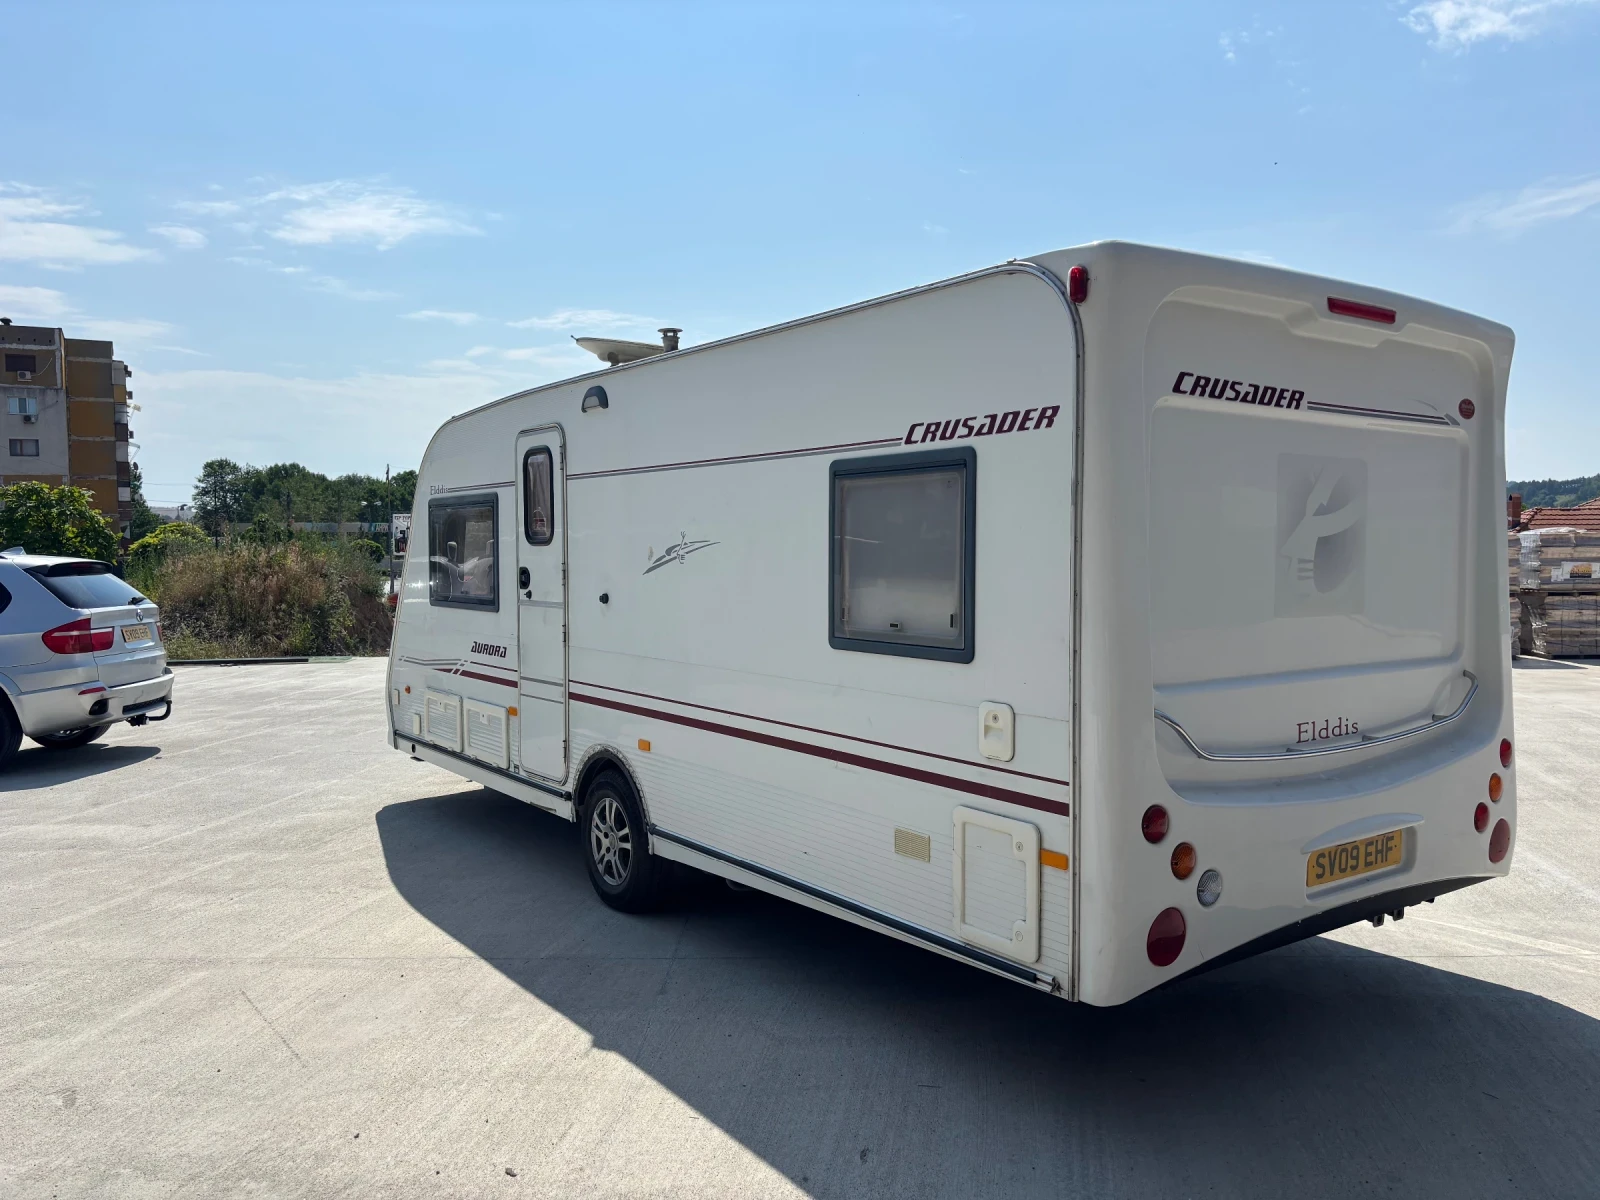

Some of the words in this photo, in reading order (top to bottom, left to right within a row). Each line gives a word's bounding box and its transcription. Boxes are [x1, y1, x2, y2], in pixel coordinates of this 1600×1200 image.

[1172, 371, 1305, 410] CRUSADER
[904, 405, 1060, 445] CRUSADER
[470, 640, 507, 658] AURORA
[1296, 717, 1359, 744] Elddis
[1315, 844, 1360, 880] SV09
[1364, 835, 1395, 868] EHF
